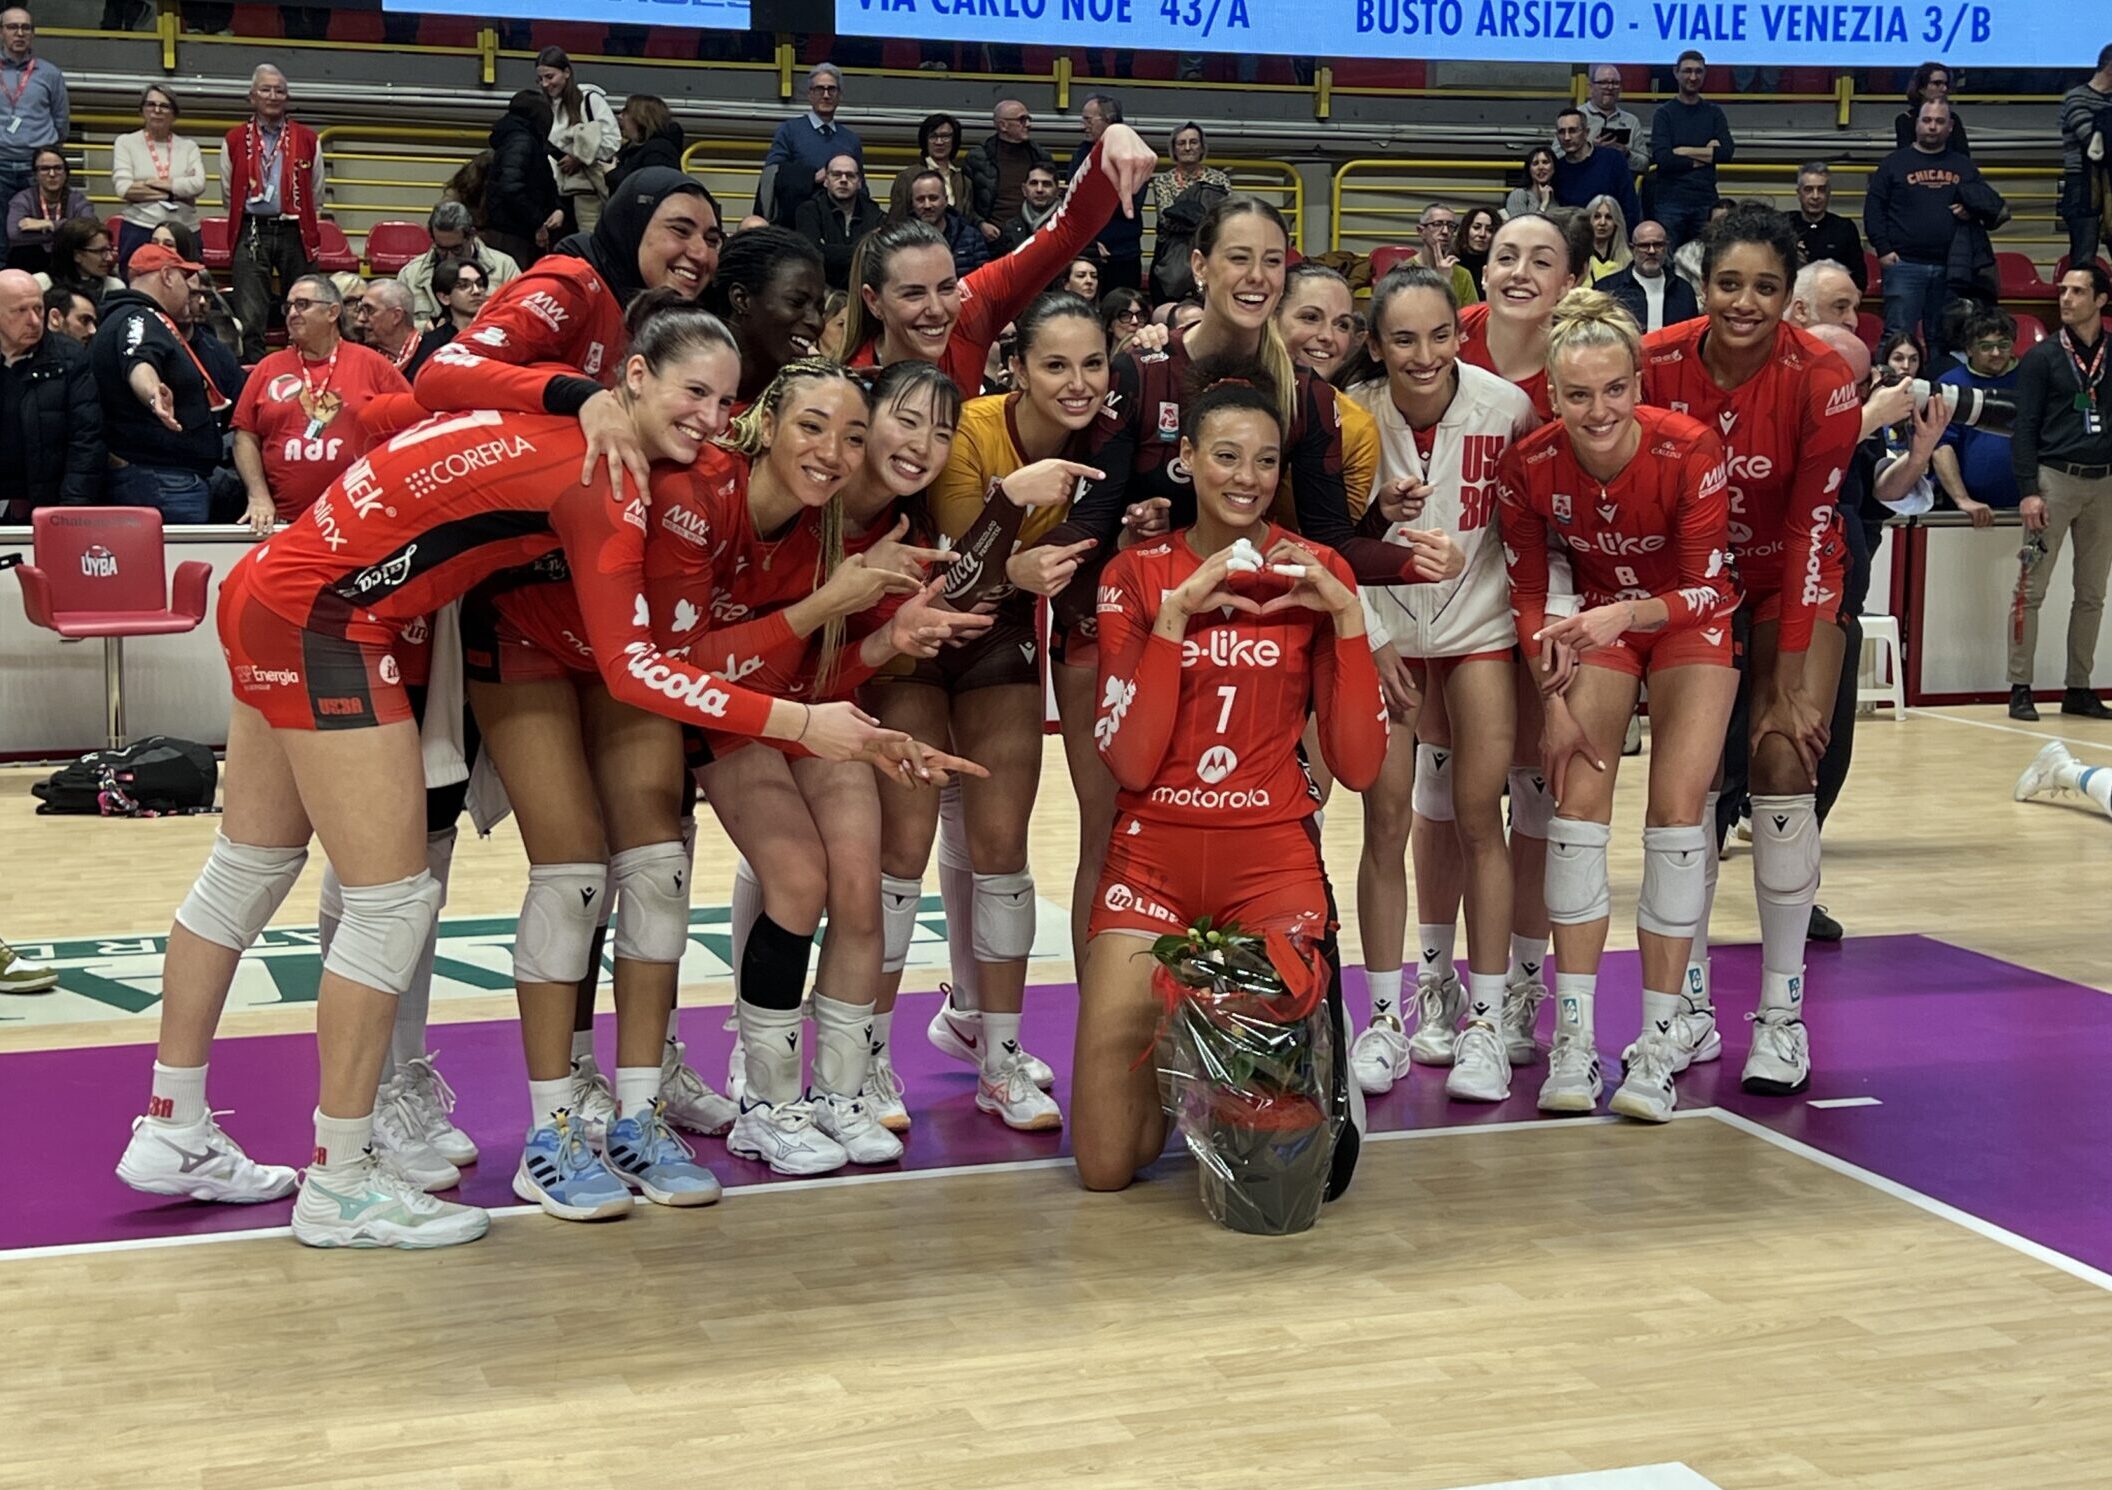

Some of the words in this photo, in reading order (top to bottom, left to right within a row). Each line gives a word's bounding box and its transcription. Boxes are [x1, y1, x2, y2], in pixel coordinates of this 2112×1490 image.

[1356, 0, 1463, 36] BUSTO
[1475, 1, 1614, 39] ARSIZIO
[1654, 3, 1747, 41] VIALE
[1761, 5, 1908, 42] VENEZIA
[1922, 3, 1991, 52] 3/B
[1907, 169, 1960, 185] CHICAGO
[429, 434, 537, 484] COREPLA
[663, 503, 711, 536] MW
[81, 551, 119, 577] UYBA
[251, 664, 299, 687] Energia
[1216, 685, 1237, 734] 7
[1151, 784, 1270, 809] motorola
